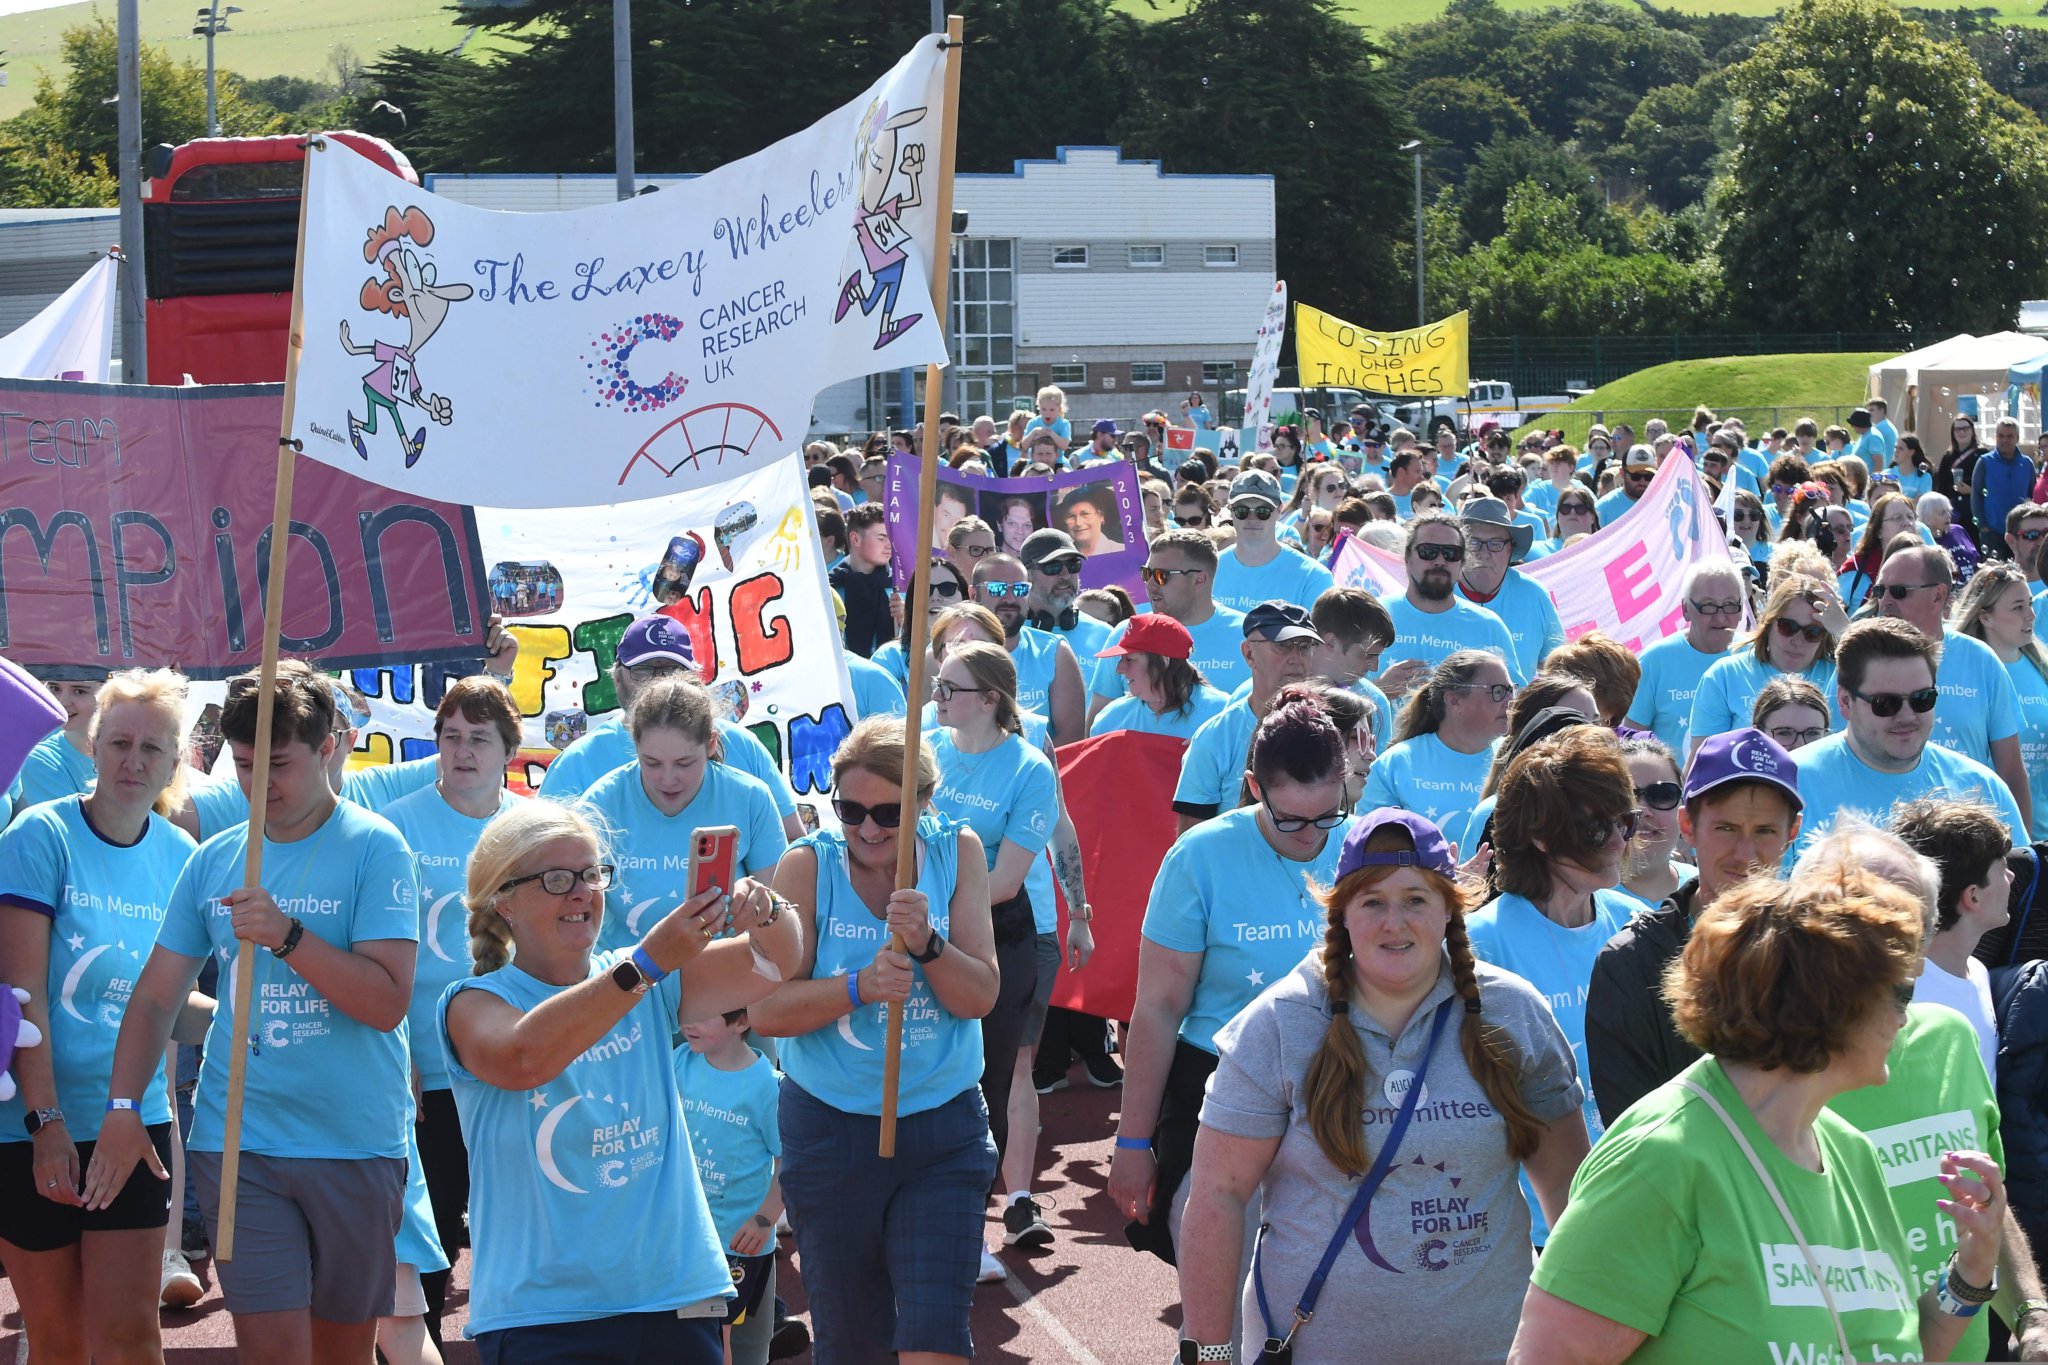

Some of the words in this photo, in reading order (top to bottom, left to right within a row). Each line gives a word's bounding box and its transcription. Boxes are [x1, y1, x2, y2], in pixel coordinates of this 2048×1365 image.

[875, 216, 895, 247] 84
[474, 252, 561, 305] The
[571, 250, 708, 301] Laxey
[699, 280, 786, 330] CANCER
[702, 295, 806, 358] RESEARCH
[1318, 315, 1446, 357] LOSING
[392, 366, 409, 394] 37
[704, 355, 735, 384] UK
[1316, 362, 1444, 394] INCHES
[1189, 658, 1235, 670] ember
[1935, 684, 1979, 698] ember
[1413, 777, 1455, 791] Team
[940, 785, 1000, 813] Member
[64, 884, 104, 911] Team
[107, 895, 167, 922] Memb
[828, 917, 877, 941] Team
[1232, 922, 1292, 942] Team
[108, 977, 133, 993] REL
[260, 983, 309, 998] RELAY
[260, 1000, 291, 1014] FOR
[295, 998, 330, 1014] LIFE
[292, 1021, 323, 1030] CANCER
[292, 1036, 304, 1045] UK
[696, 1099, 750, 1127] Member
[1361, 1099, 1492, 1126] ommittee
[591, 1141, 626, 1158] FOR
[630, 1126, 660, 1150] LIFE
[593, 1115, 641, 1143] RELAY
[1877, 1127, 1975, 1168] ARITANS
[1411, 1197, 1470, 1217] RELAY
[1411, 1216, 1451, 1235] FOR
[1456, 1210, 1489, 1232] LIFE
[1453, 1237, 1482, 1248] CANCER
[1453, 1244, 1492, 1257] RESEARCH
[1453, 1257, 1466, 1266] UK
